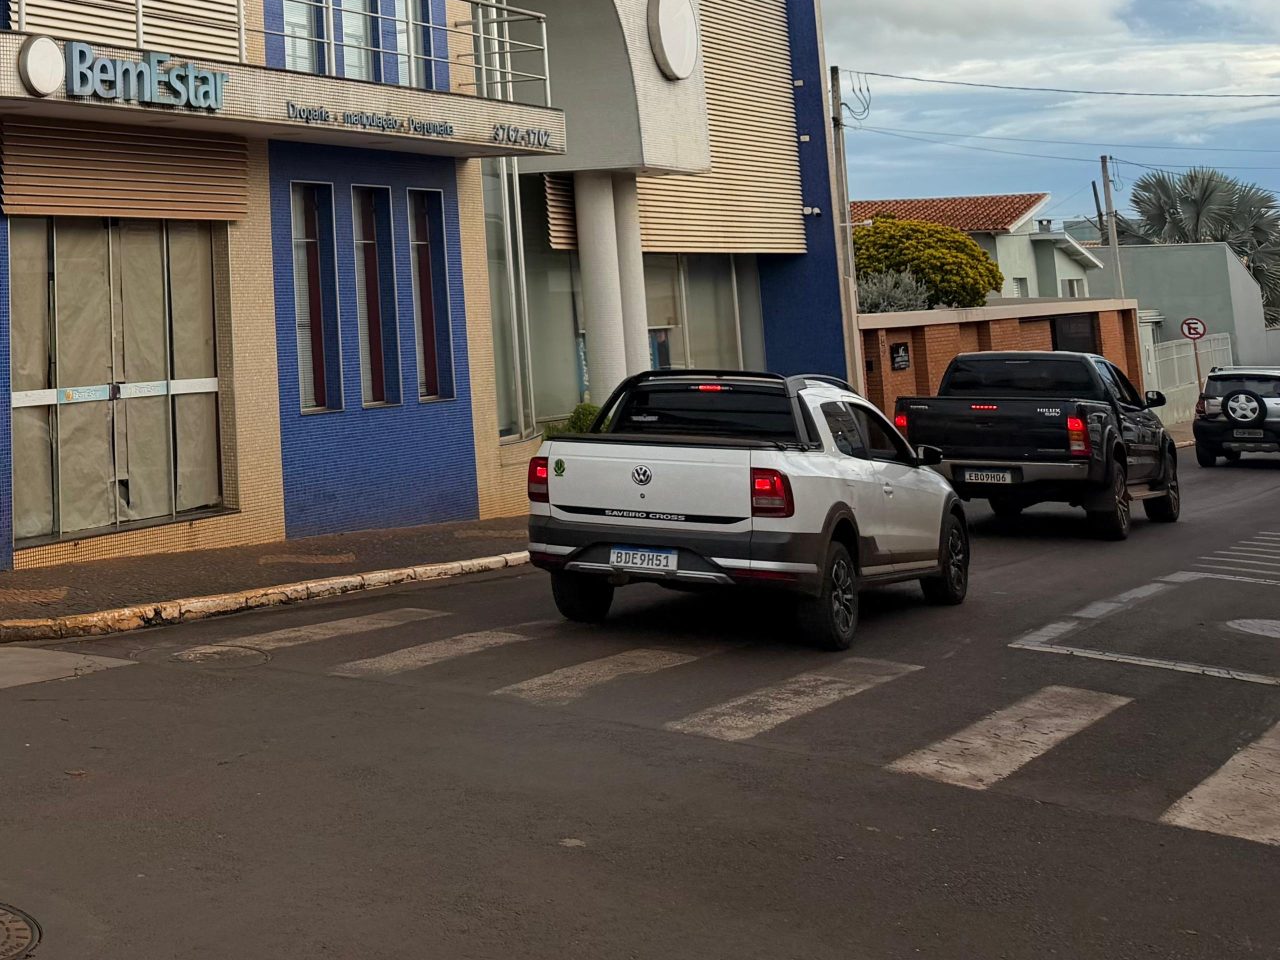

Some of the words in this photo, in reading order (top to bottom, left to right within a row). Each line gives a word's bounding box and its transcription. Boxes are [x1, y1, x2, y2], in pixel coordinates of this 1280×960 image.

[66, 41, 229, 110] BemEstar
[287, 102, 330, 123] Drogaria
[604, 510, 647, 518] SAVEIRO
[649, 513, 686, 521] CROSS
[615, 551, 670, 568] BDE9H51
